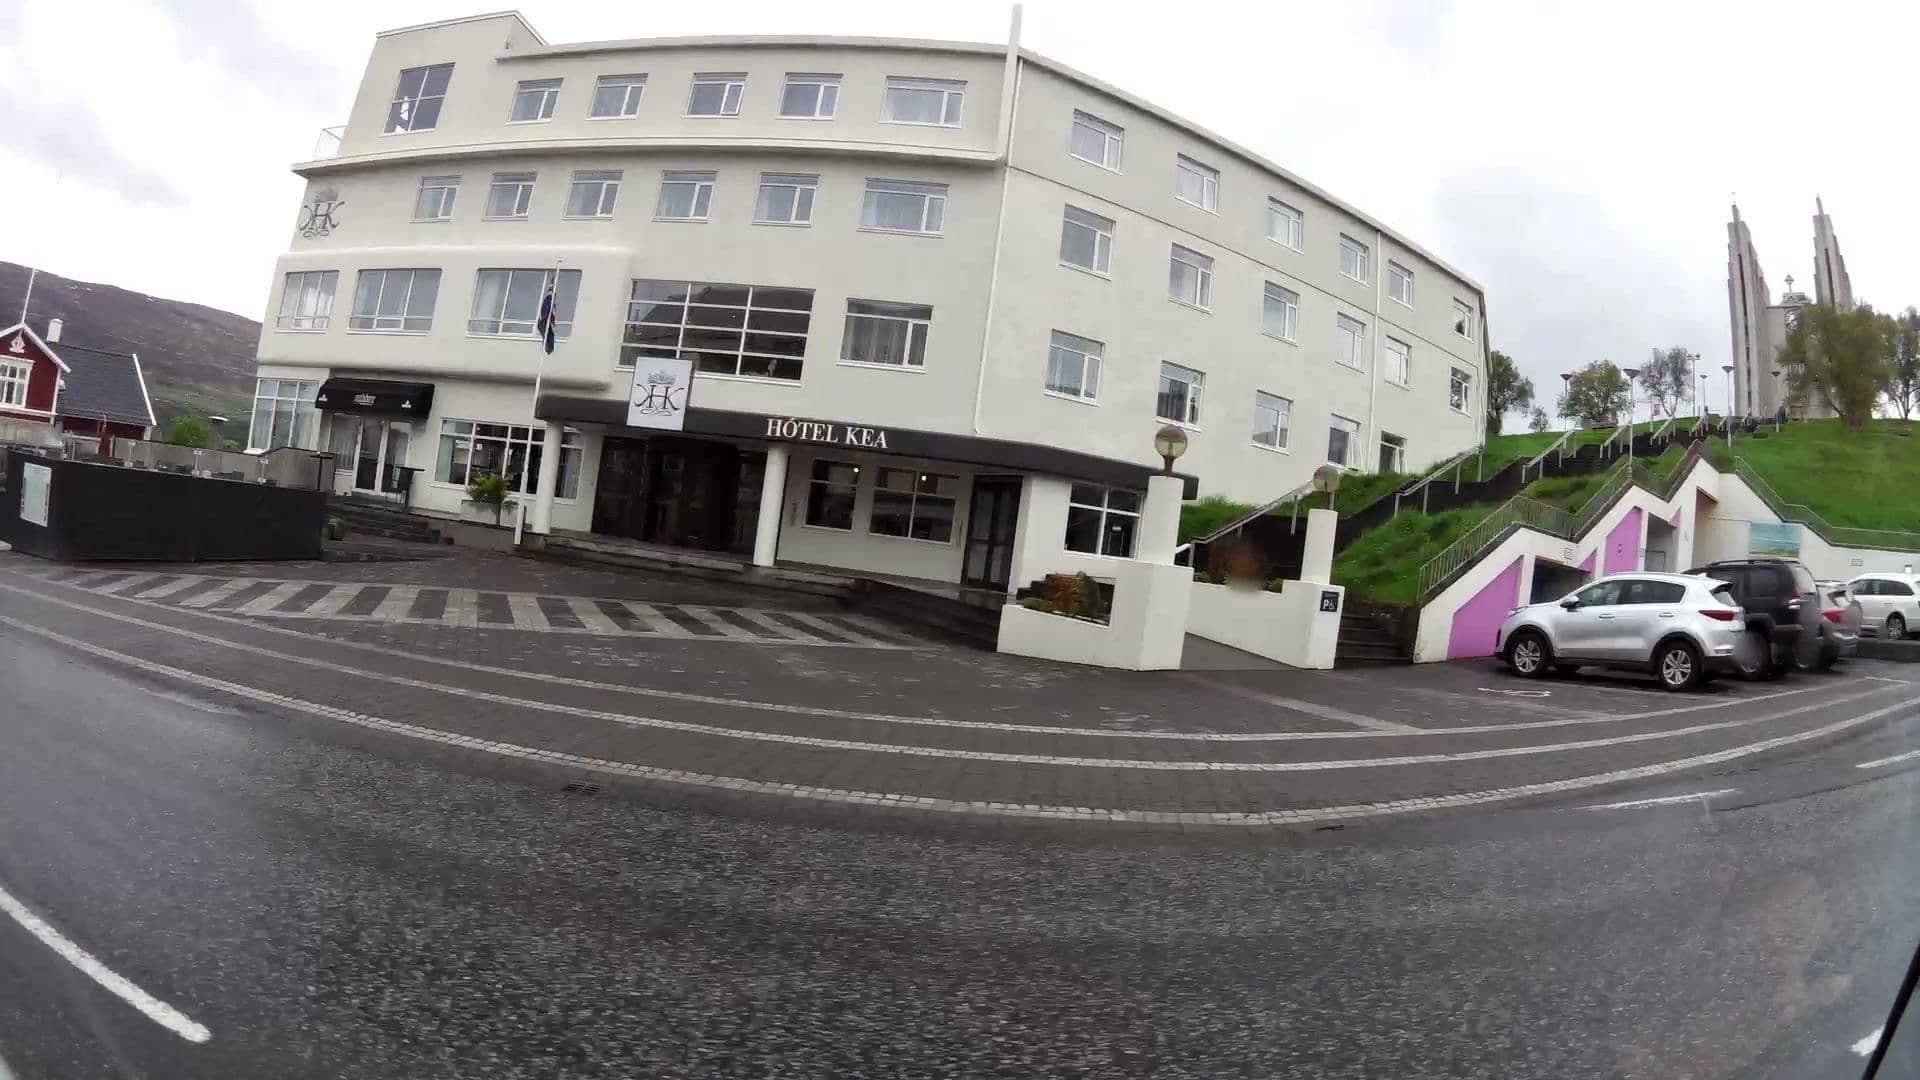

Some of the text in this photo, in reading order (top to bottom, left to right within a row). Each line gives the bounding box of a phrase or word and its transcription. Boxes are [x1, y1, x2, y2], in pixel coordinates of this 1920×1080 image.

[765, 417, 888, 449] HÓTEL KEA
[1322, 599, 1330, 610] P
